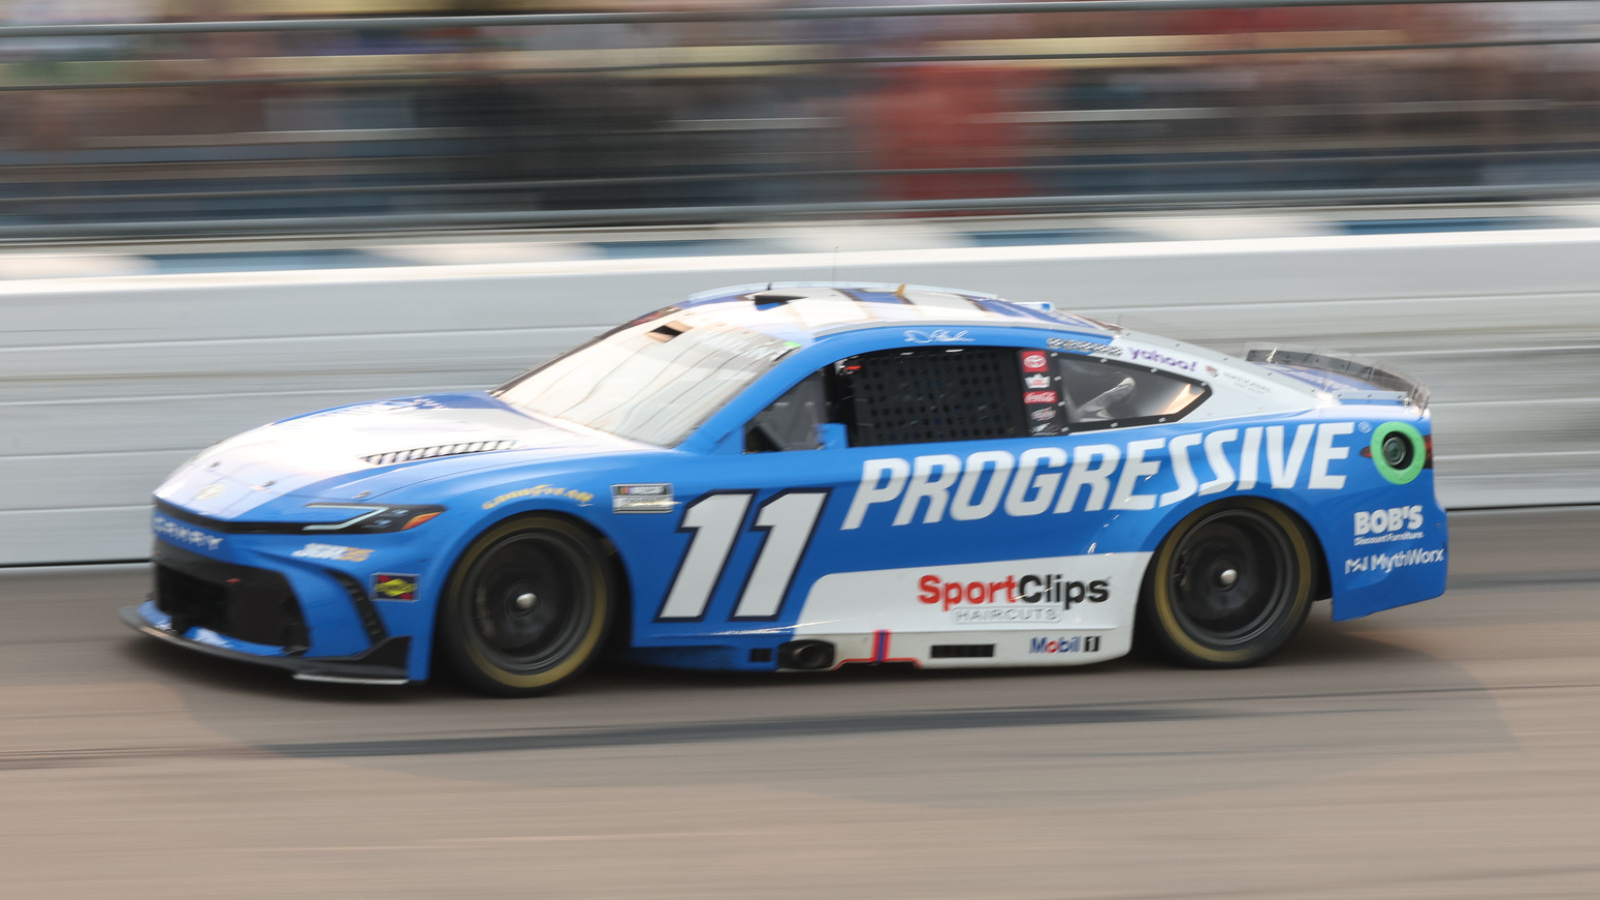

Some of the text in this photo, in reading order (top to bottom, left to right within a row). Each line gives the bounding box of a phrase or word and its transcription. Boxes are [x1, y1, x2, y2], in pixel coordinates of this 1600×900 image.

[1128, 346, 1197, 372] yahoo!
[840, 421, 1355, 531] PROGRESSIVE
[1353, 505, 1424, 536] BOB'S
[652, 486, 834, 624] 11
[1371, 548, 1444, 573] MythWorx
[954, 606, 1060, 622] HAIRCUTS
[1029, 635, 1102, 654] Mobil 1
